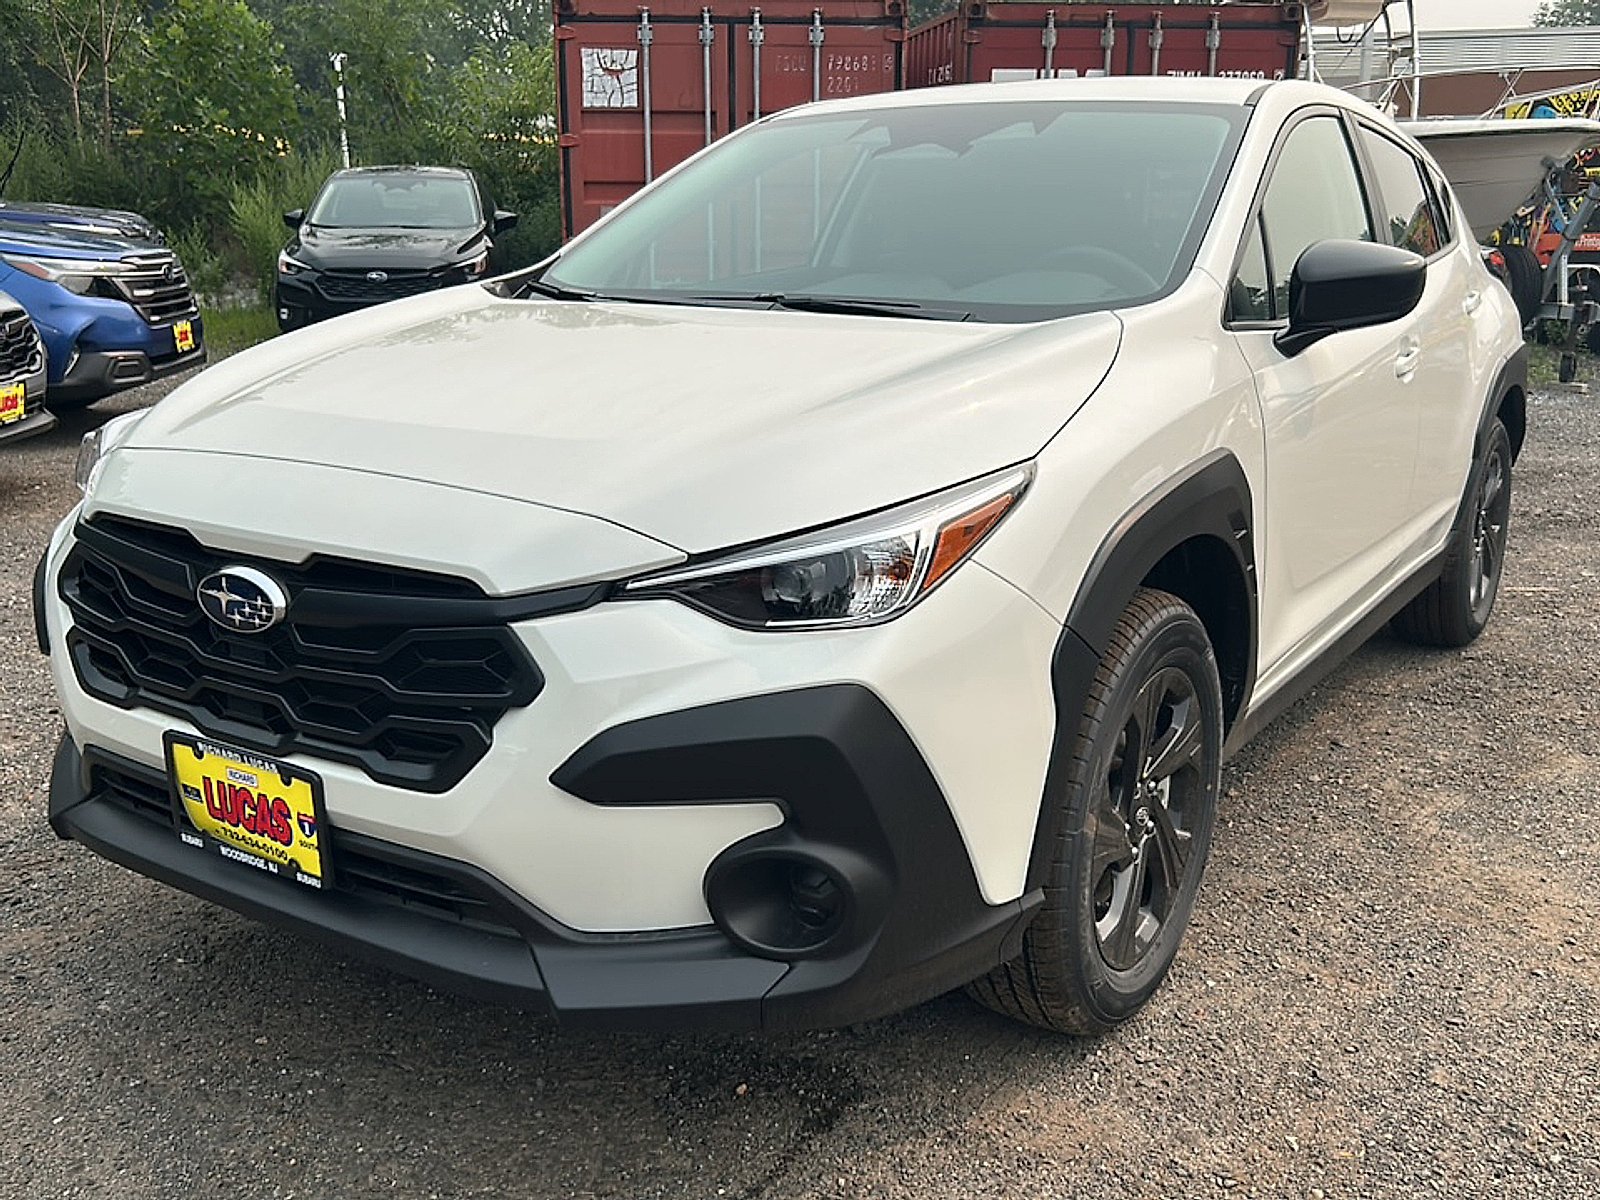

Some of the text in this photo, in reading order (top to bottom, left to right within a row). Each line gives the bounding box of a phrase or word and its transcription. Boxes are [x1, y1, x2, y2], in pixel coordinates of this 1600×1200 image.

[197, 741, 278, 774] RICHARD LUCAS
[228, 770, 256, 785] RICHARD
[202, 775, 292, 847] LUCAS
[303, 821, 311, 836] 1
